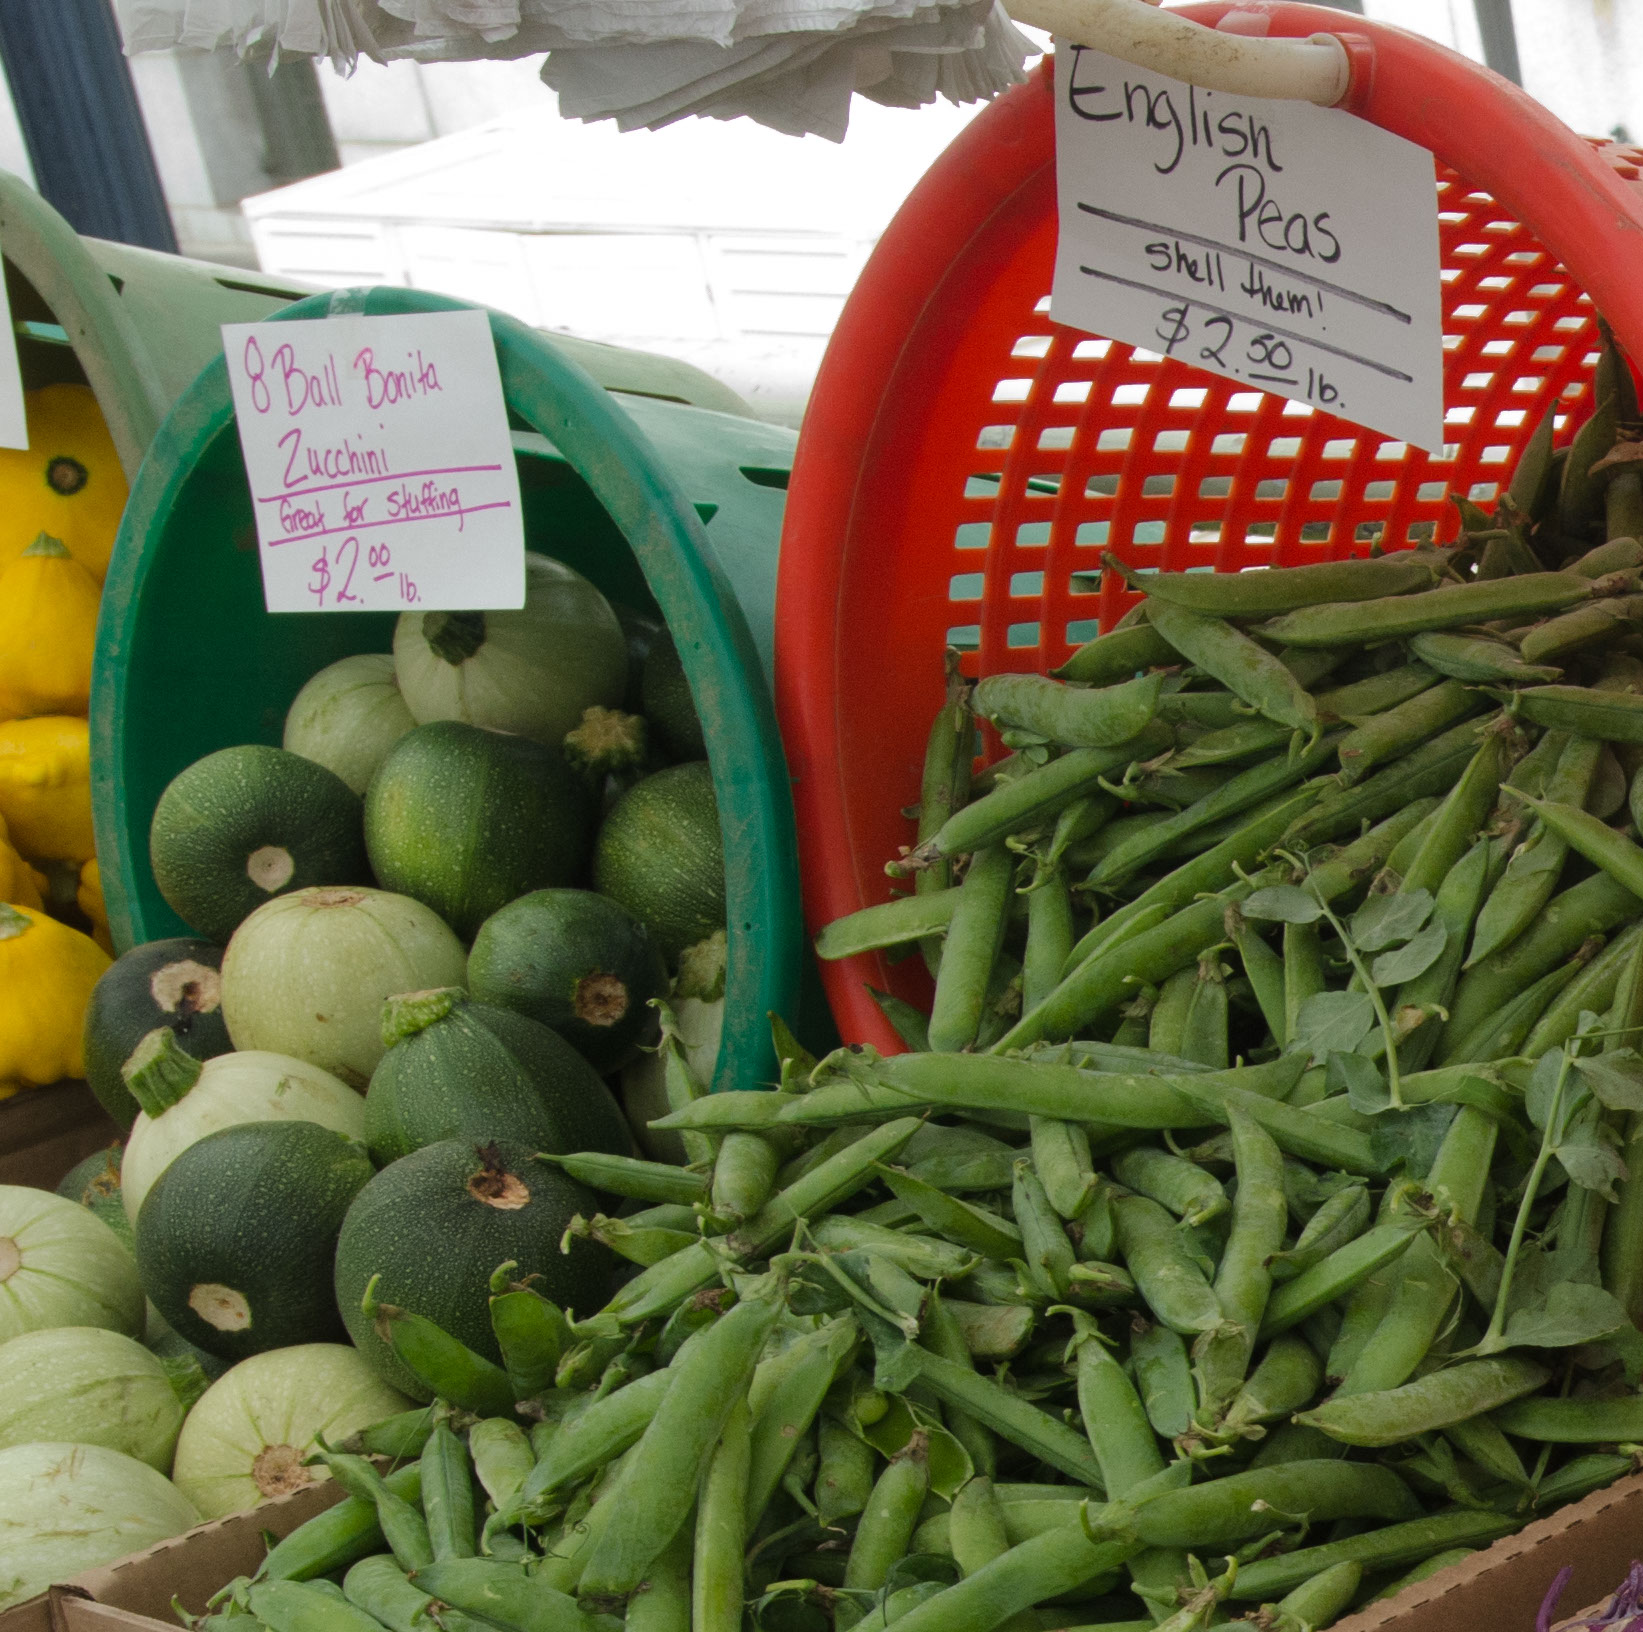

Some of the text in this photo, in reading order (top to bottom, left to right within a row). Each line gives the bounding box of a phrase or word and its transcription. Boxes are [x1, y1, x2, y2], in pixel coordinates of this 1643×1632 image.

[1069, 43, 1283, 175] English
[1215, 164, 1341, 263] Peas
[1241, 263, 1327, 331] them!
[245, 336, 443, 415] 8 Ball Bonita
[1308, 367, 1346, 409] lb.
[278, 423, 389, 489] Zucchini
[279, 495, 325, 534] Great
[343, 491, 368, 528] for
[399, 573, 421, 602] lb.
